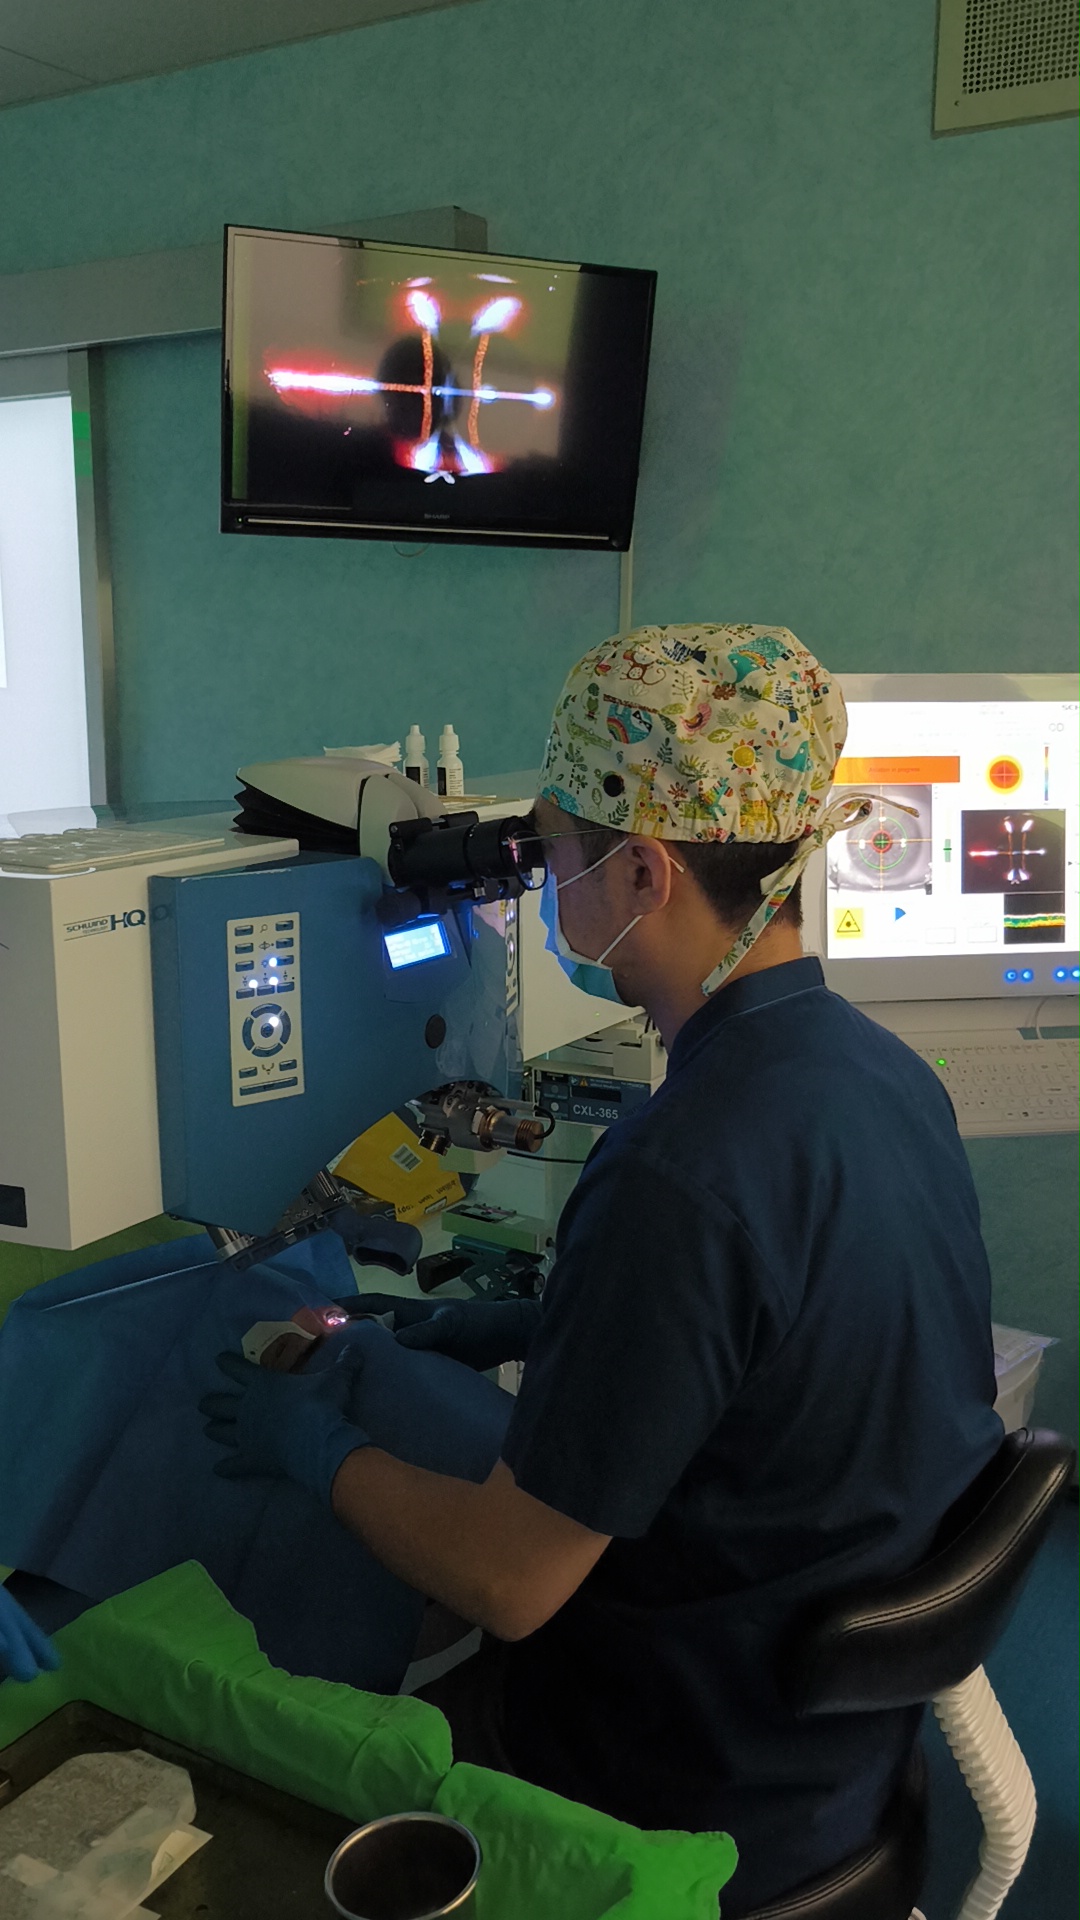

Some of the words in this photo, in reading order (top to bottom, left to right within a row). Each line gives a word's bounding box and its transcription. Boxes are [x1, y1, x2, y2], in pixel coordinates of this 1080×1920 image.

[66, 918, 108, 933] SCHWIND
[110, 908, 146, 931] HQ
[572, 1104, 619, 1120] CXL-365
